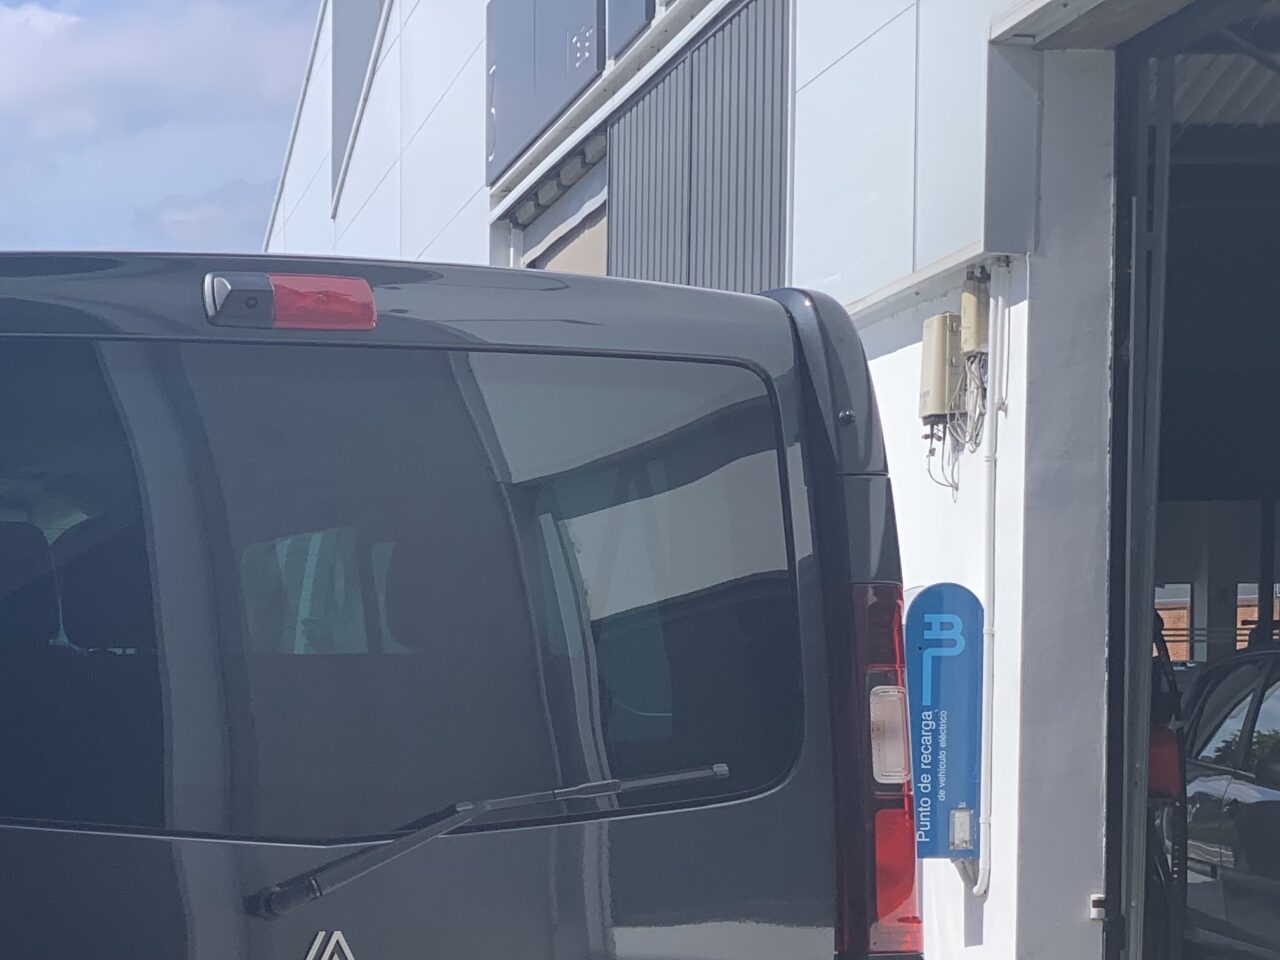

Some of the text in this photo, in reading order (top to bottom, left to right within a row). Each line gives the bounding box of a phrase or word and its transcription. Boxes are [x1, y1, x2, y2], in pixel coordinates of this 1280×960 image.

[916, 710, 936, 842] Punto de recarga
[937, 789, 946, 801] de
